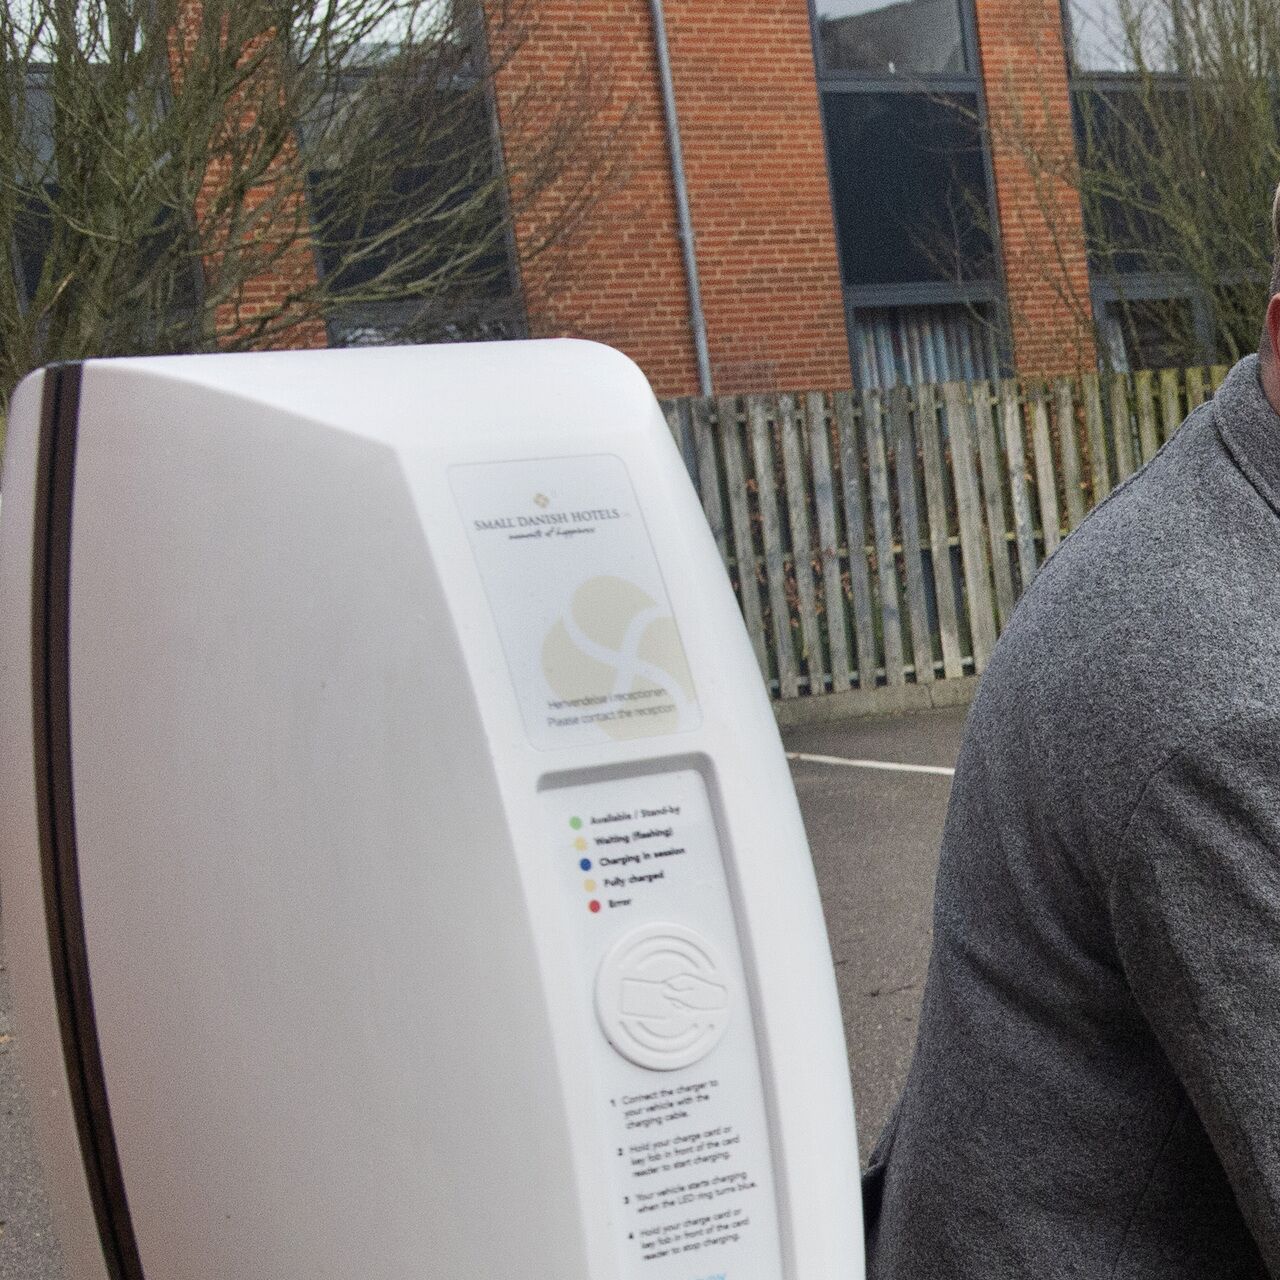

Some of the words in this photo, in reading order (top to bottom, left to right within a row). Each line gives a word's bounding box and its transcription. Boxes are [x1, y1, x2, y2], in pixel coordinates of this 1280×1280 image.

[473, 517, 515, 530] SMALL
[517, 512, 568, 527] DANISH
[570, 509, 620, 522] HOTELS
[547, 716, 579, 727] Please
[581, 712, 616, 723] contact
[617, 710, 632, 718] the
[634, 705, 676, 717] reception
[591, 812, 631, 824] Available
[594, 836, 630, 845] Waiting
[600, 855, 640, 866] Charging
[654, 849, 685, 857] session
[604, 876, 625, 887] Fully
[628, 870, 664, 883] charged
[609, 899, 631, 908] Error
[622, 1092, 657, 1104] Connect
[660, 1089, 673, 1097] the
[677, 1083, 707, 1093] charger
[624, 1107, 642, 1119] your
[646, 1101, 673, 1111] vehicle
[677, 1097, 693, 1105] with
[696, 1094, 709, 1102] the
[626, 1116, 662, 1129] charging
[630, 1143, 649, 1152] Hold
[653, 1139, 669, 1151] your
[673, 1134, 700, 1144] charge
[703, 1127, 721, 1137] card
[707, 1141, 719, 1149] the
[723, 1135, 740, 1145] card
[633, 1167, 658, 1177] reader
[657, 1185, 684, 1195] vehicle
[712, 1172, 747, 1185] charging
[638, 1204, 658, 1213] when
[662, 1200, 675, 1208] the
[678, 1194, 695, 1204] LED
[698, 1192, 713, 1200] ring
[640, 1227, 660, 1236] Hold
[663, 1223, 681, 1234] your
[684, 1217, 710, 1227] charge
[713, 1210, 731, 1220] card
[732, 1216, 749, 1228] card
[644, 1251, 669, 1260] reader
